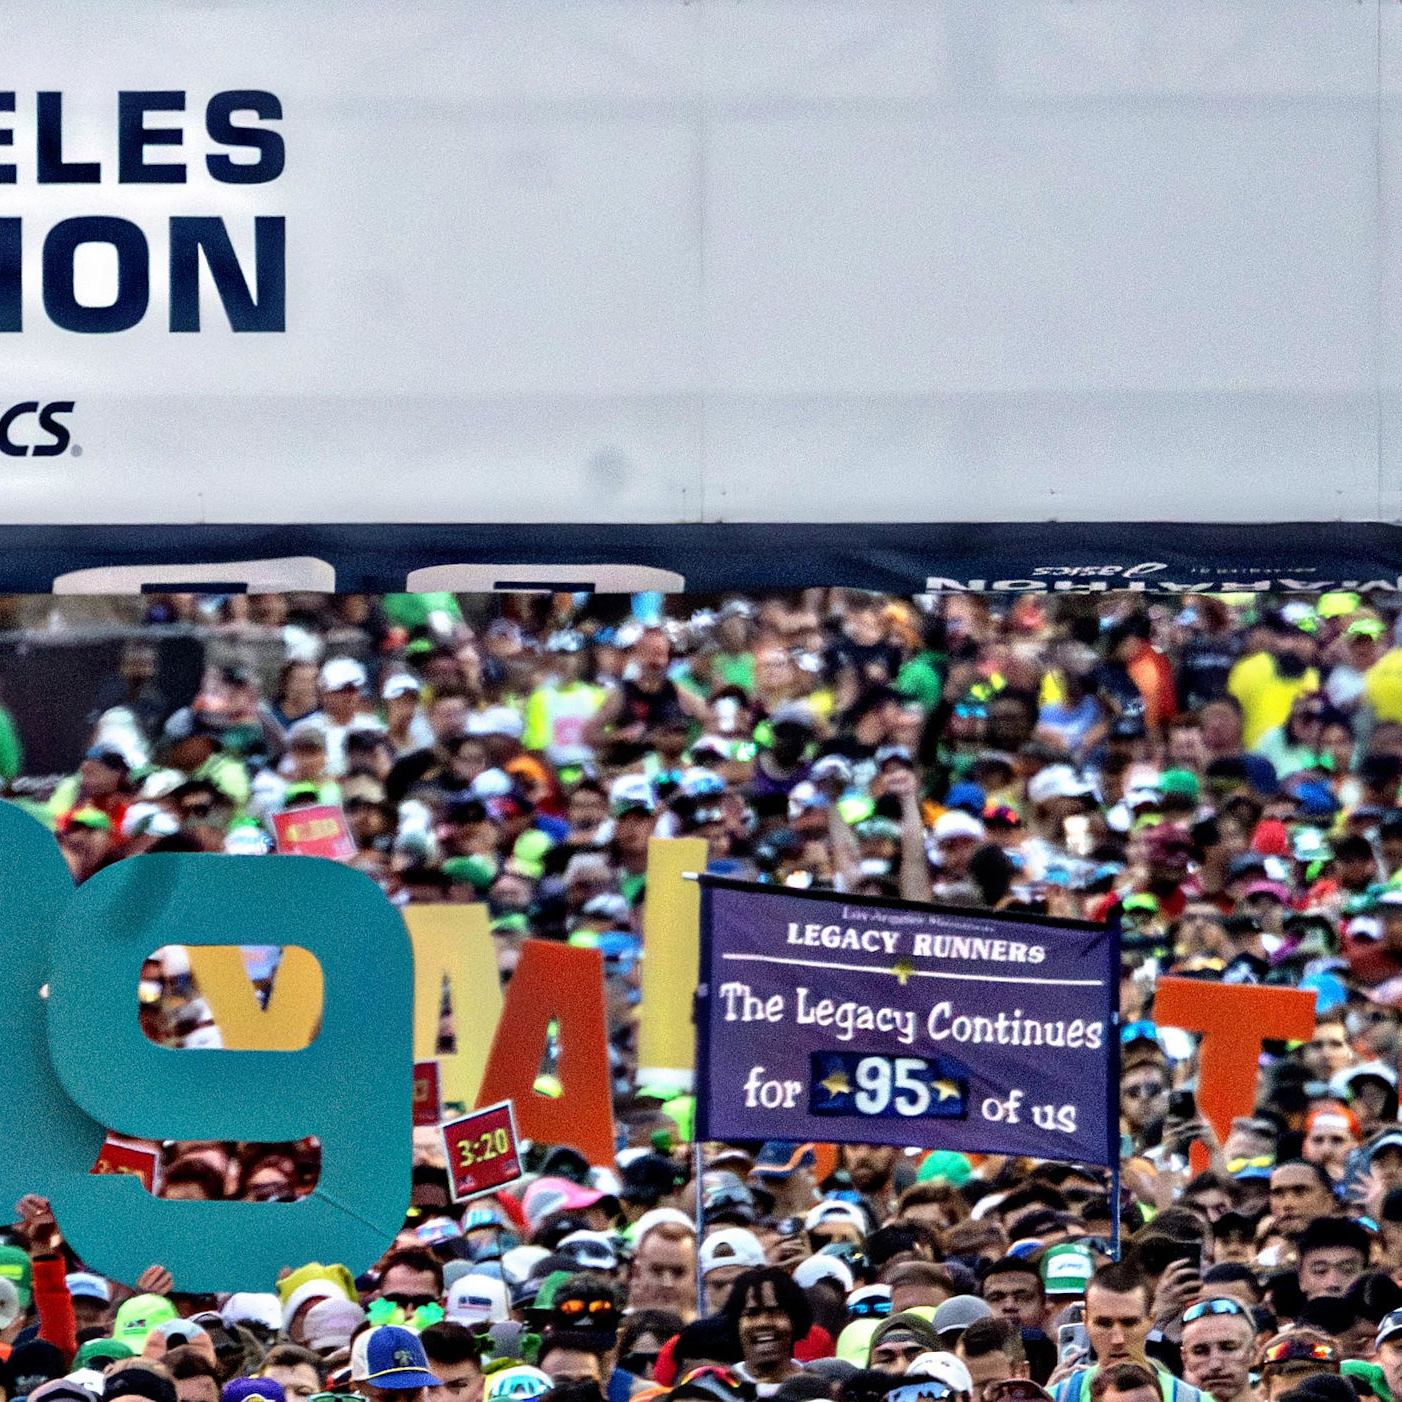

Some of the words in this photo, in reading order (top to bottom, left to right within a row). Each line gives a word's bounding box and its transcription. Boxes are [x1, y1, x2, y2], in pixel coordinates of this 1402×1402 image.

[787, 922, 900, 954] LEGACY
[913, 933, 1046, 964] RUNNERS
[720, 986, 785, 1023] The
[797, 987, 915, 1043] Legacy
[928, 1001, 1103, 1050] Continues
[743, 1066, 802, 1109] for
[854, 1056, 932, 1117] 95
[981, 1090, 1024, 1124] of
[1032, 1103, 1078, 1134] us
[456, 1127, 509, 1168] 3:20
